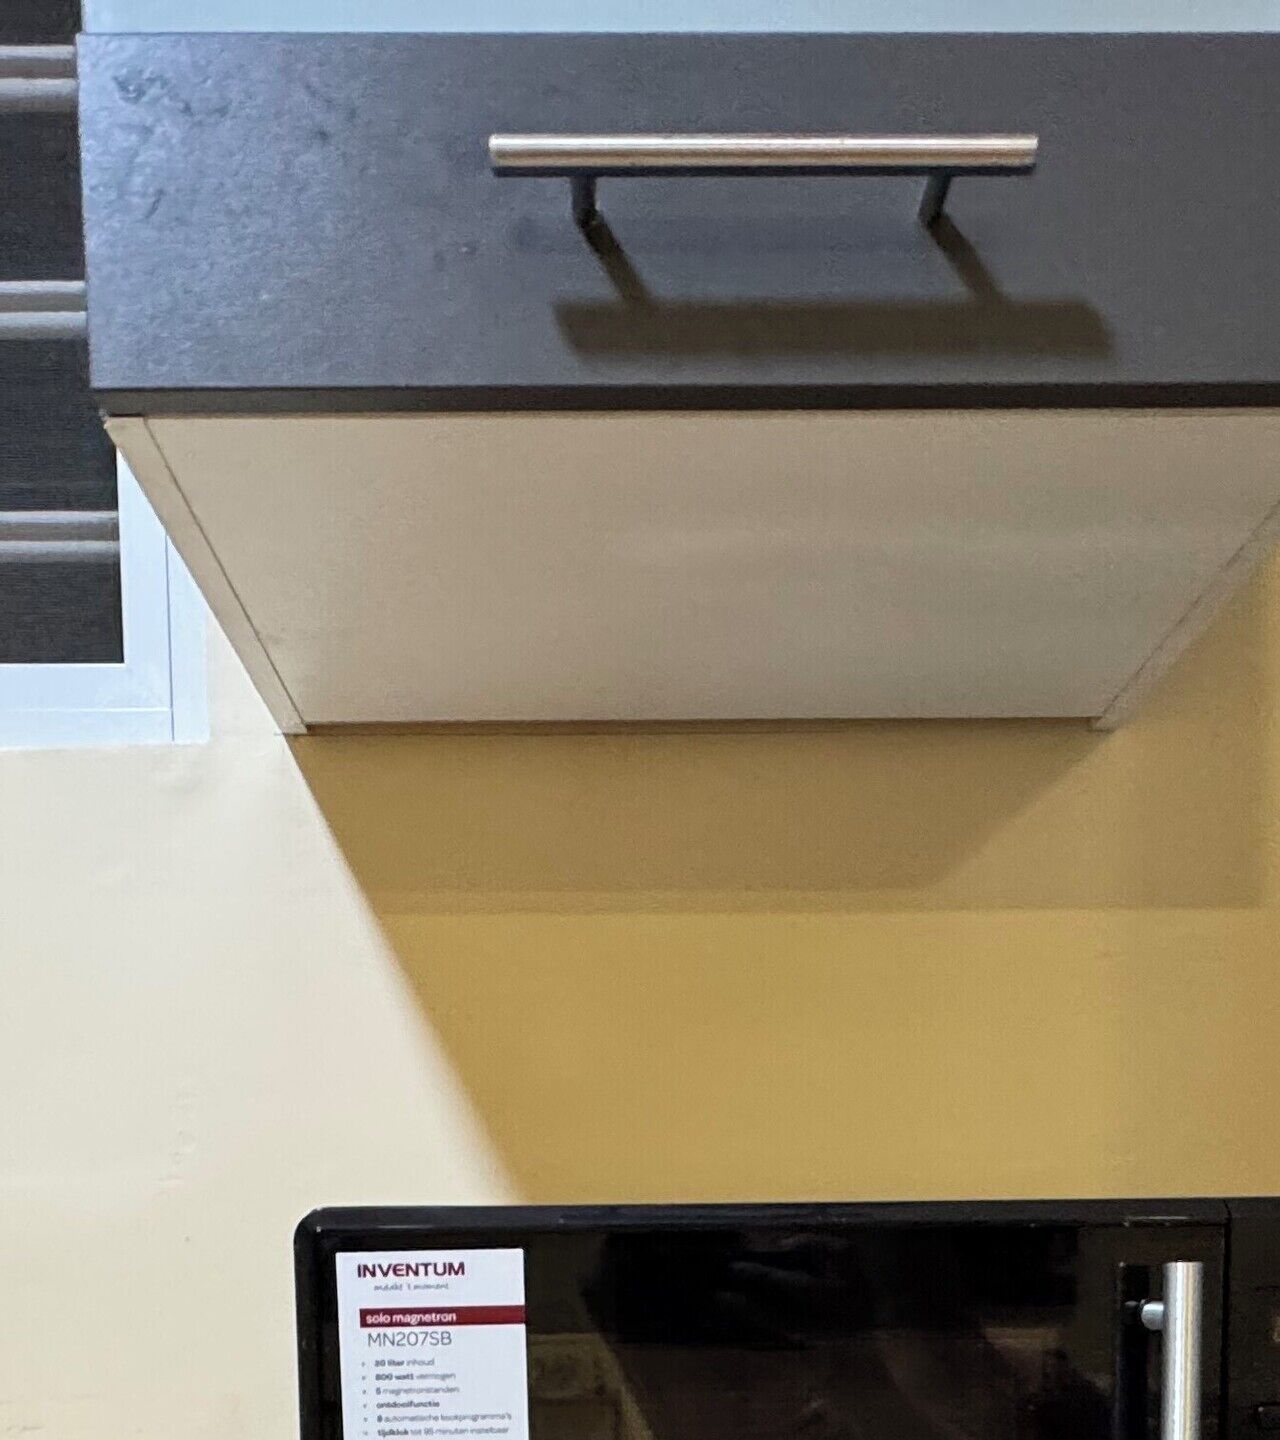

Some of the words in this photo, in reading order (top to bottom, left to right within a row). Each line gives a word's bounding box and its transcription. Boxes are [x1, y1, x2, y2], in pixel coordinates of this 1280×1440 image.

[357, 1262, 466, 1278] INVENTUM
[366, 1311, 391, 1325] solo
[392, 1311, 457, 1326] magnetron
[367, 1331, 453, 1348] MN207SB
[375, 1373, 393, 1381] 800
